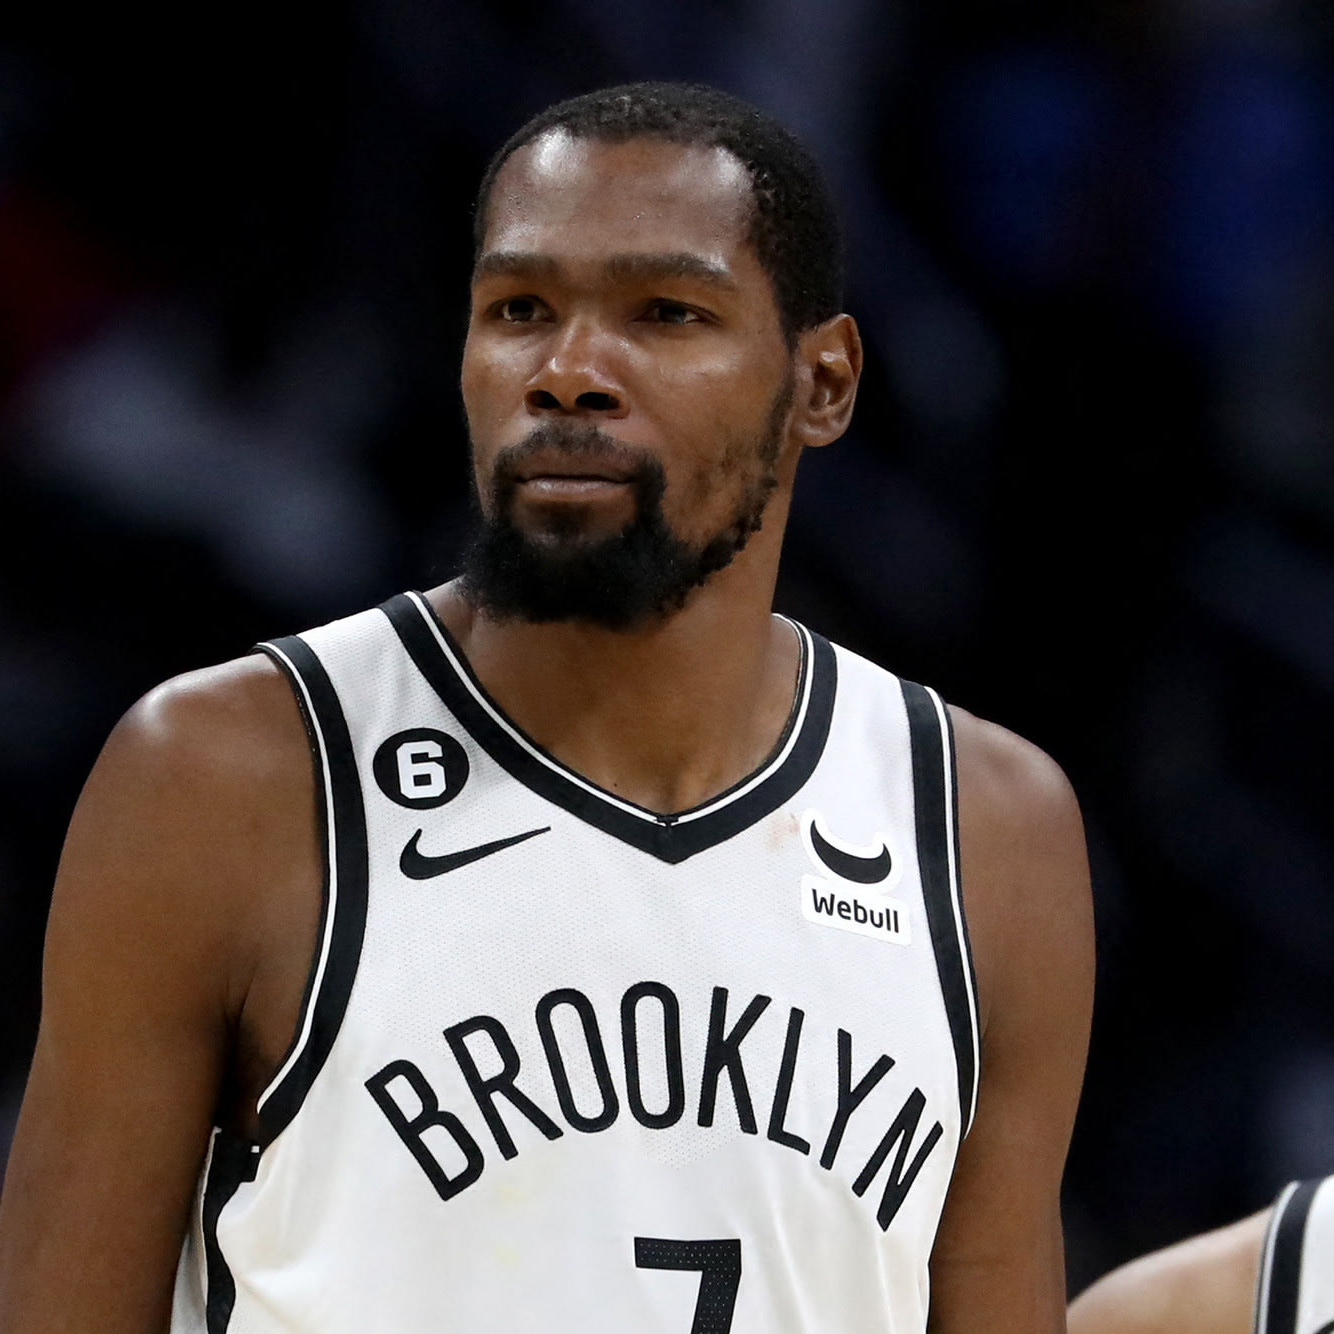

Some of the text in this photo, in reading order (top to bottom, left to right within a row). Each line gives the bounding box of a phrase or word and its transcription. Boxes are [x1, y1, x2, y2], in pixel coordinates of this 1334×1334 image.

[396, 740, 447, 799] 6
[812, 888, 899, 933] Webull
[364, 981, 944, 1233] BROOKLYN
